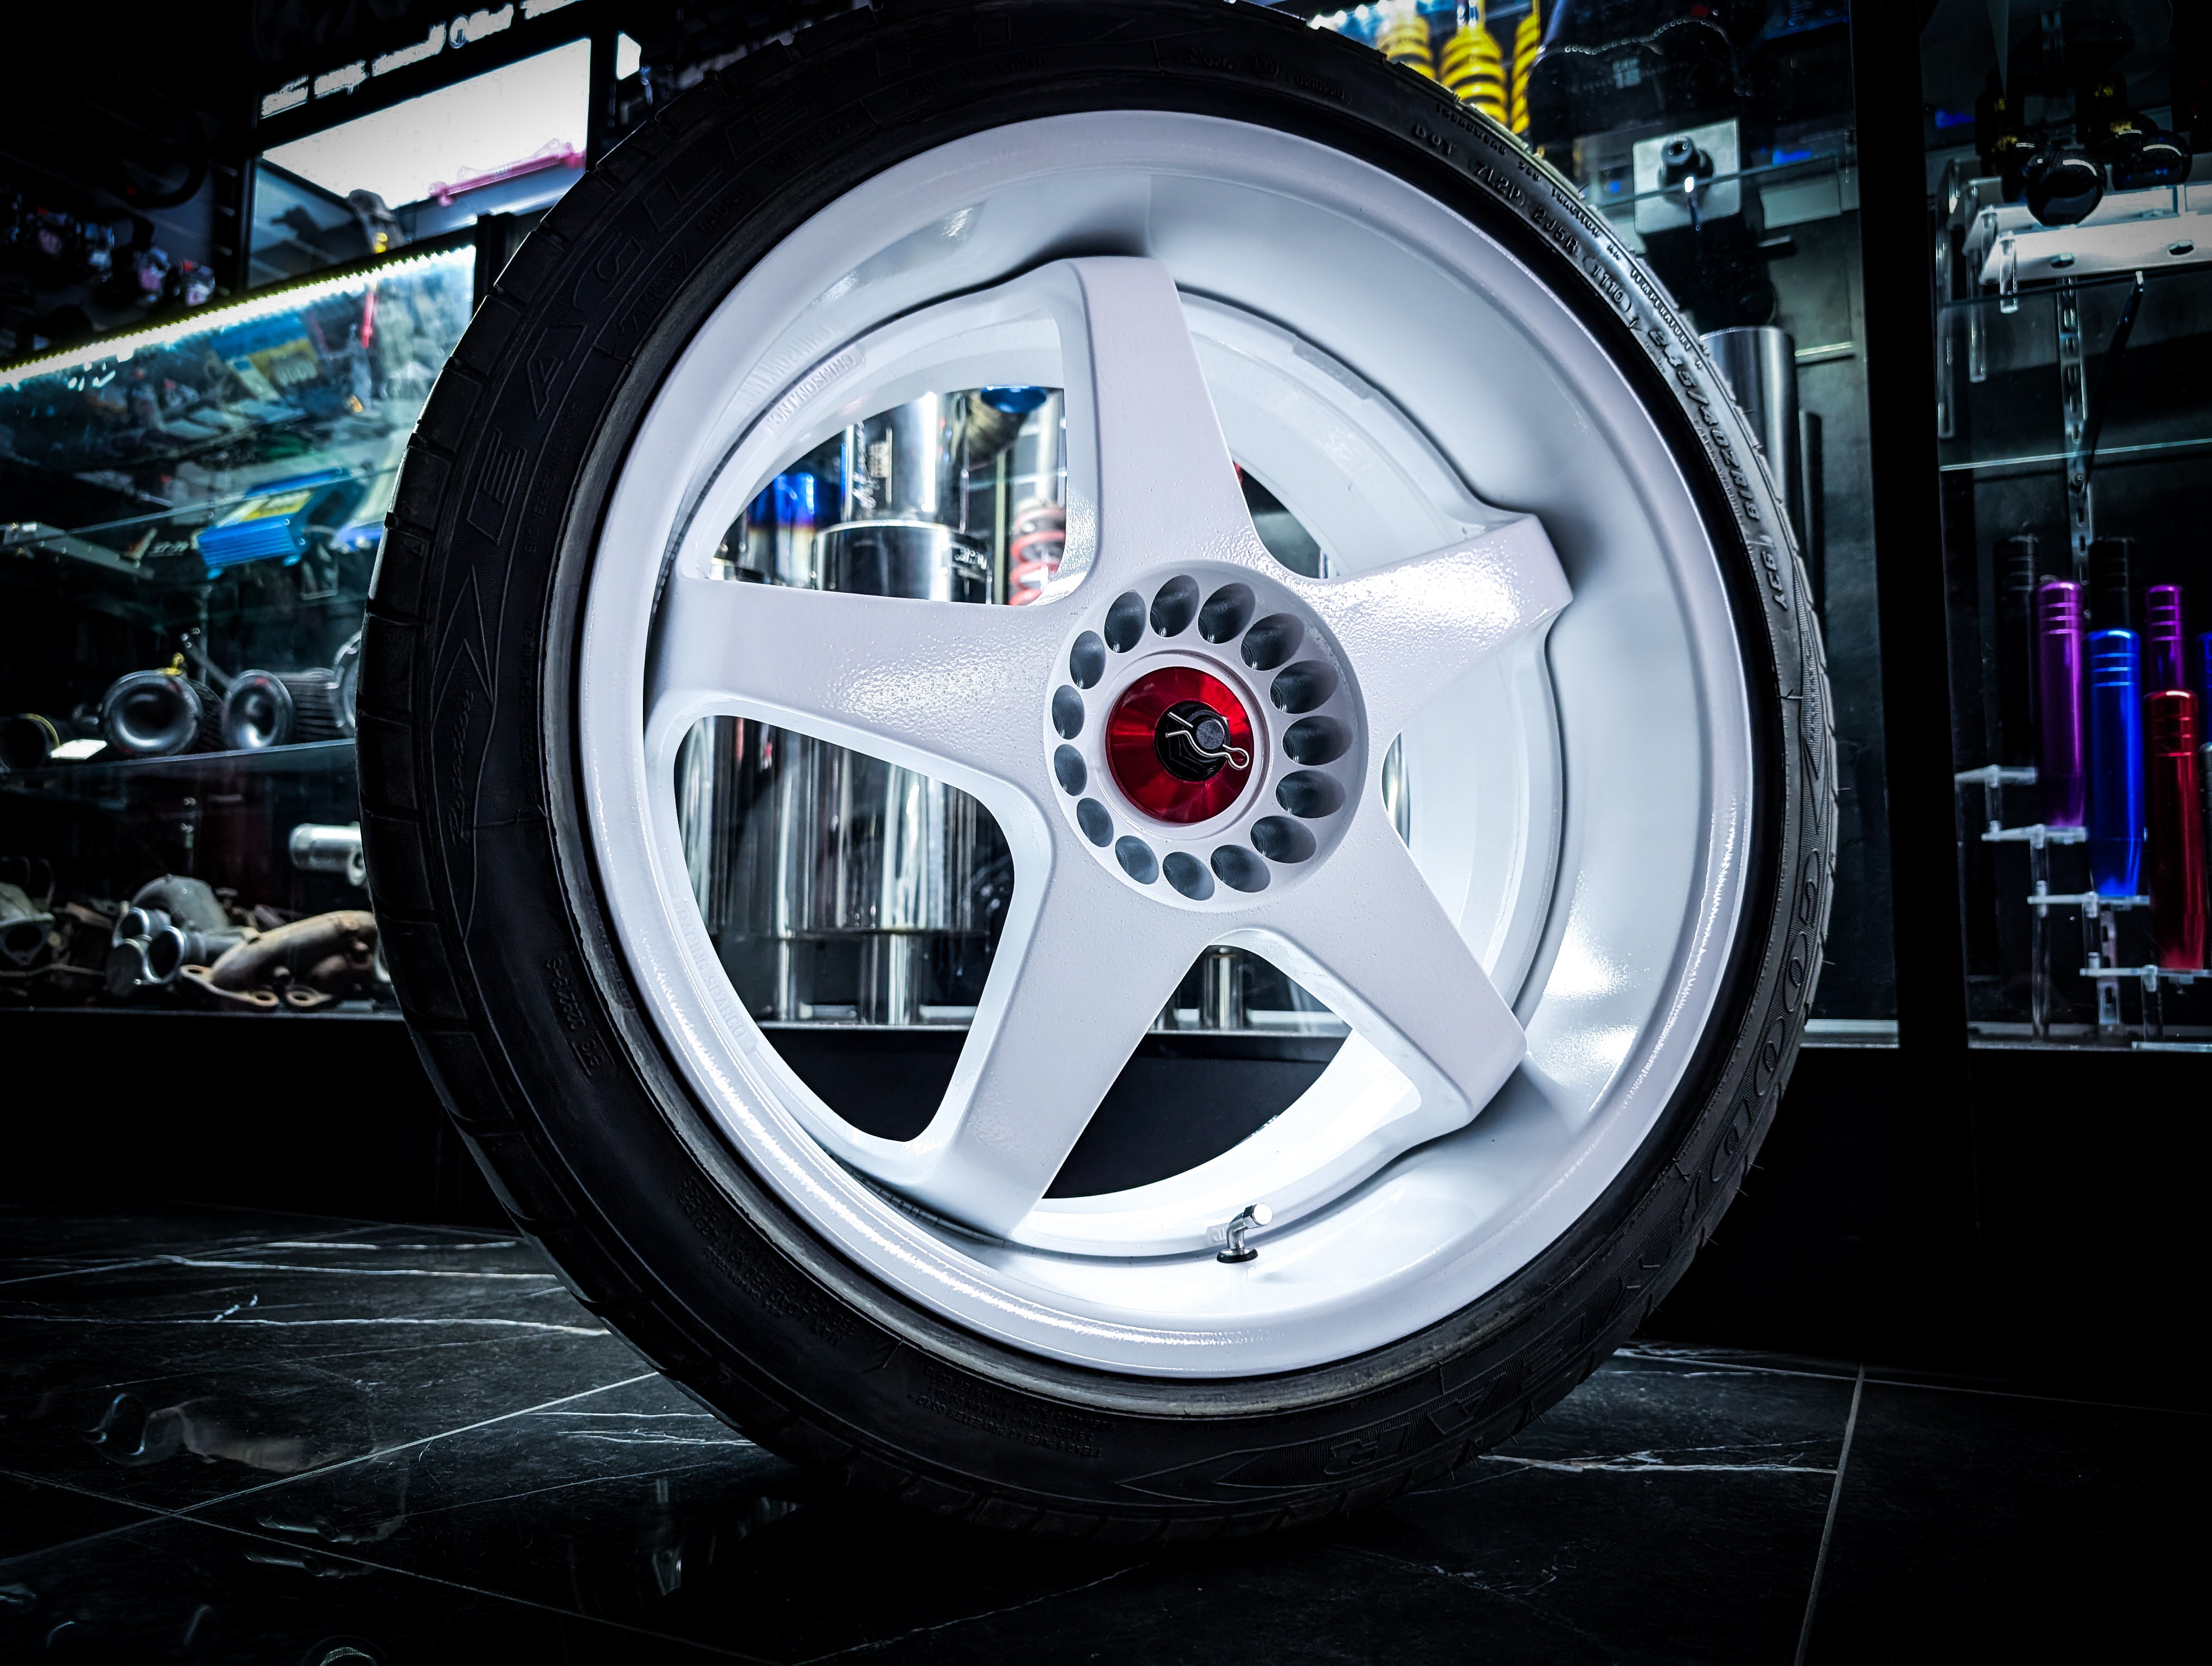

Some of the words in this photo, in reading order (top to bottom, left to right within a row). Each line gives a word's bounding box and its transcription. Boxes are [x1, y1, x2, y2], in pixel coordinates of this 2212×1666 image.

[892, 76, 947, 104] MADE
[1412, 120, 1458, 164] DOT
[691, 183, 755, 236] RADIAL
[467, 81, 809, 546] EAGLE
[1648, 330, 1761, 520] 245/40ZR18
[1323, 848, 1823, 1476] GOODYEAR
